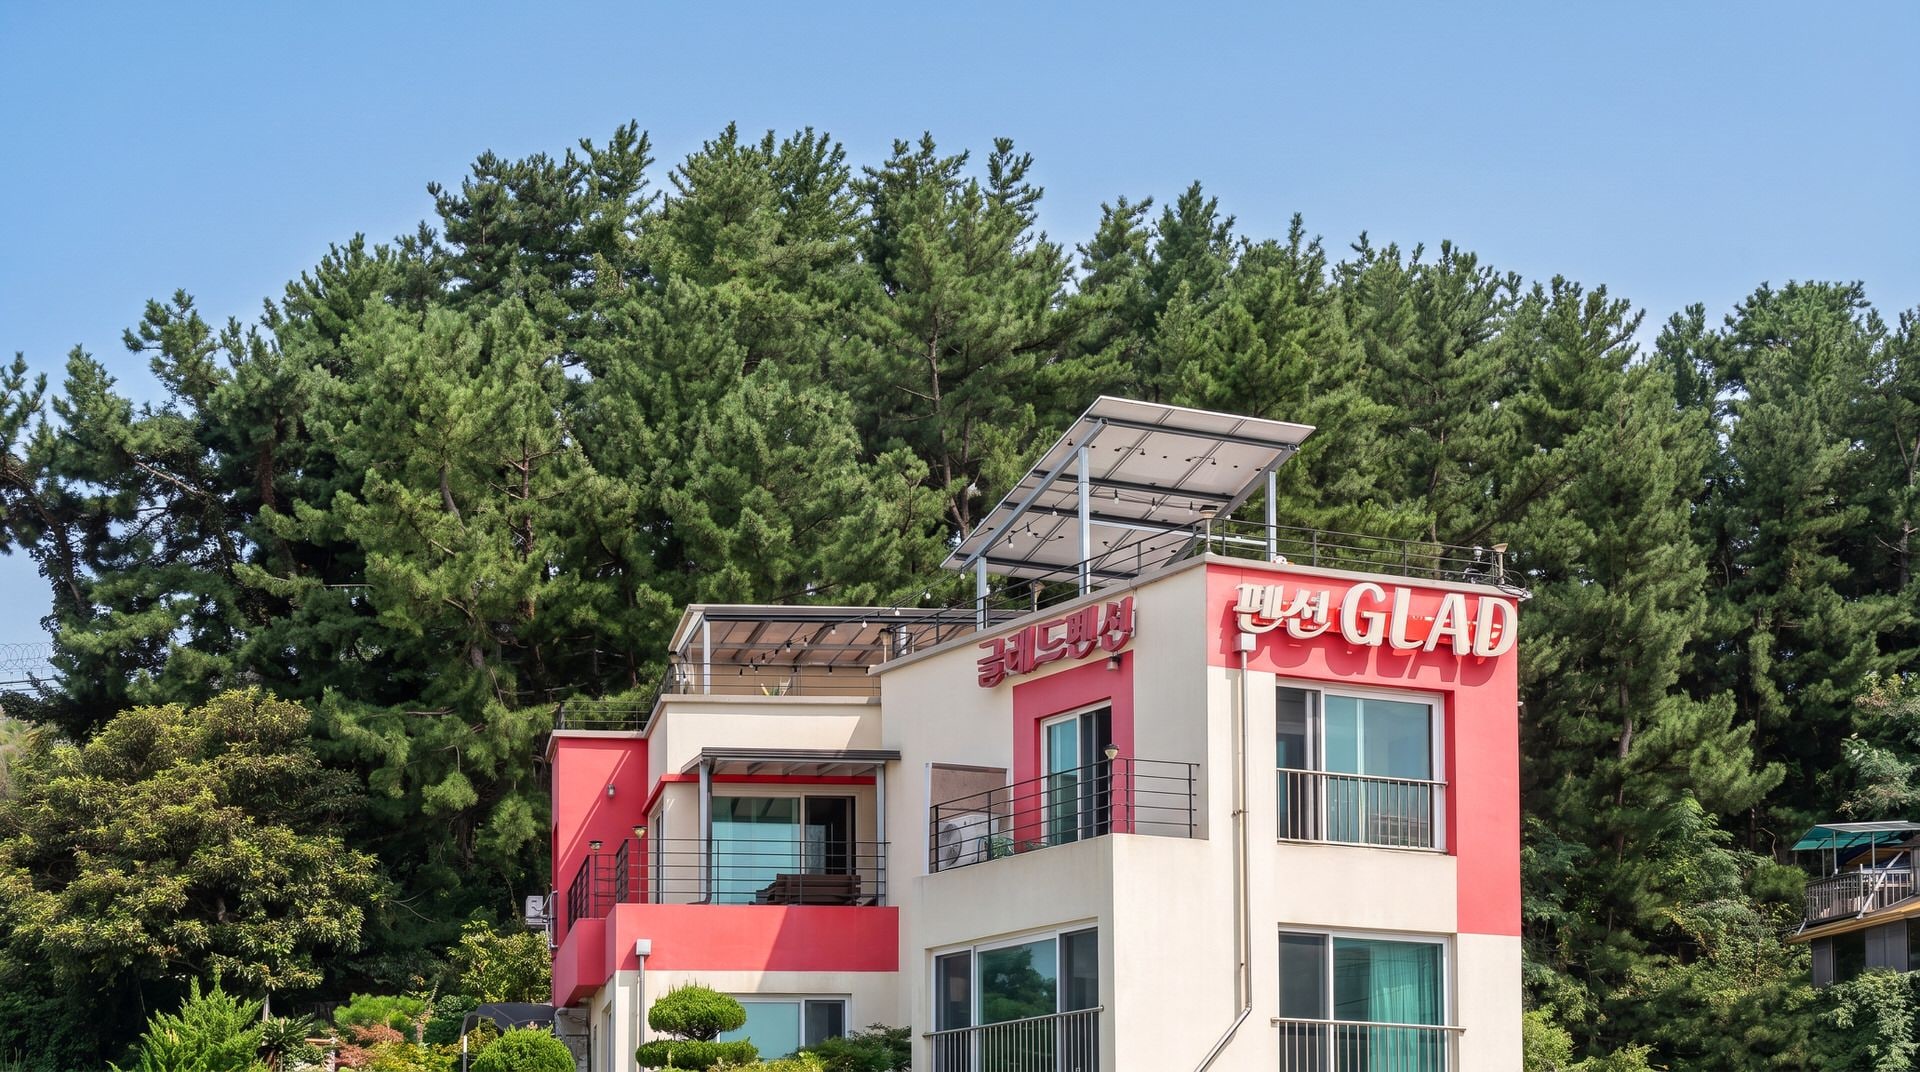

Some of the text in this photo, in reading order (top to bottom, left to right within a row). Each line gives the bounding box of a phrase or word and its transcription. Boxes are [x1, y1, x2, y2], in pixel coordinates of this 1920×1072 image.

[977, 596, 1133, 688] 글레드펜션
[1233, 582, 1518, 657] 펜션 GLAD
